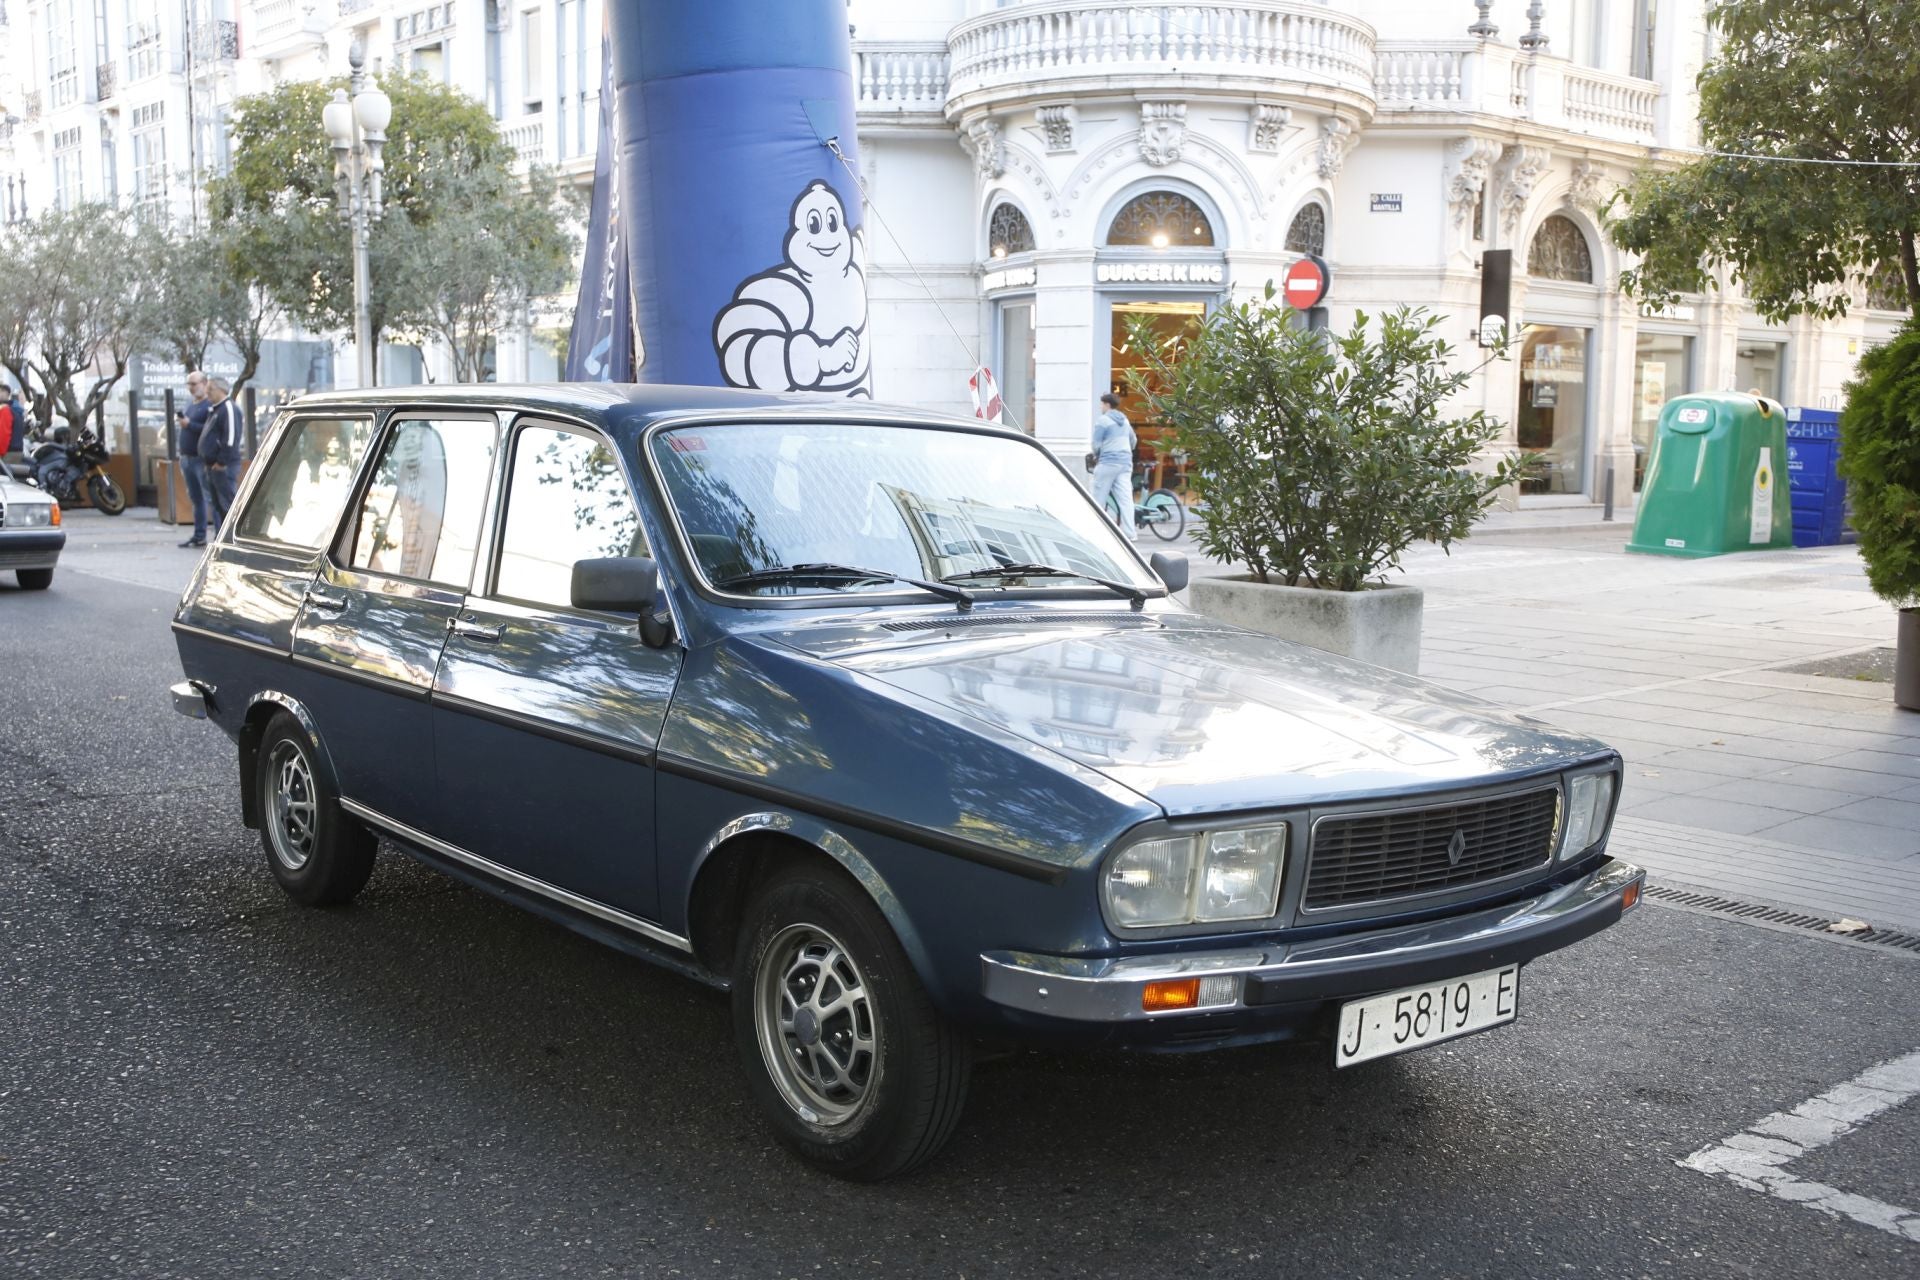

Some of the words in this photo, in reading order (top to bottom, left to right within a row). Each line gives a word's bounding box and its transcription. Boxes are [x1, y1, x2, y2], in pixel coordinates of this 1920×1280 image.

[1097, 264, 1172, 281] BURGER
[1173, 265, 1223, 282] KING
[142, 361, 170, 372] Todo
[213, 362, 239, 373] fácil
[143, 374, 185, 384] cuando
